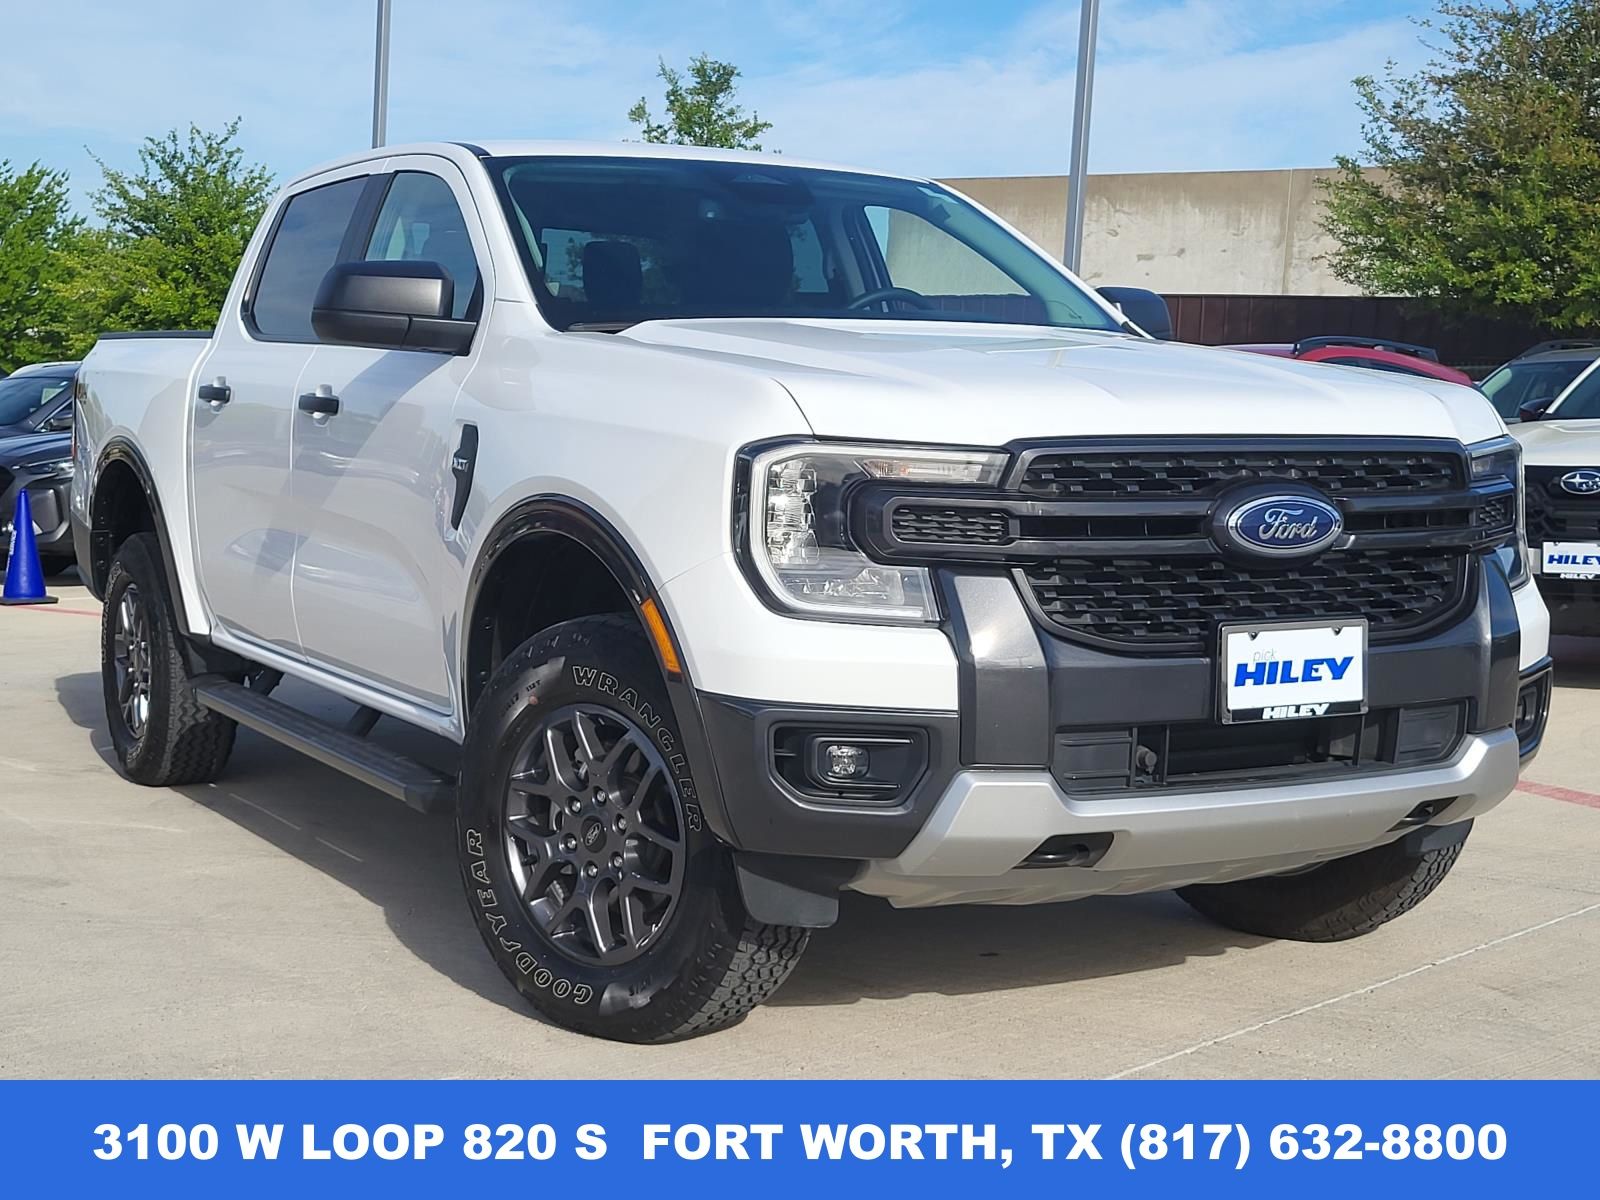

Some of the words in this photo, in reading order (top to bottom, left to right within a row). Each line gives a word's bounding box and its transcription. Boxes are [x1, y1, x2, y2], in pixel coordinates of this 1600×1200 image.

[1259, 508, 1318, 540] Ford
[1234, 656, 1354, 687] HILEY
[1262, 703, 1330, 720] HILEY
[572, 665, 702, 832] WRANGLER
[466, 828, 593, 1005] GOODYEAR
